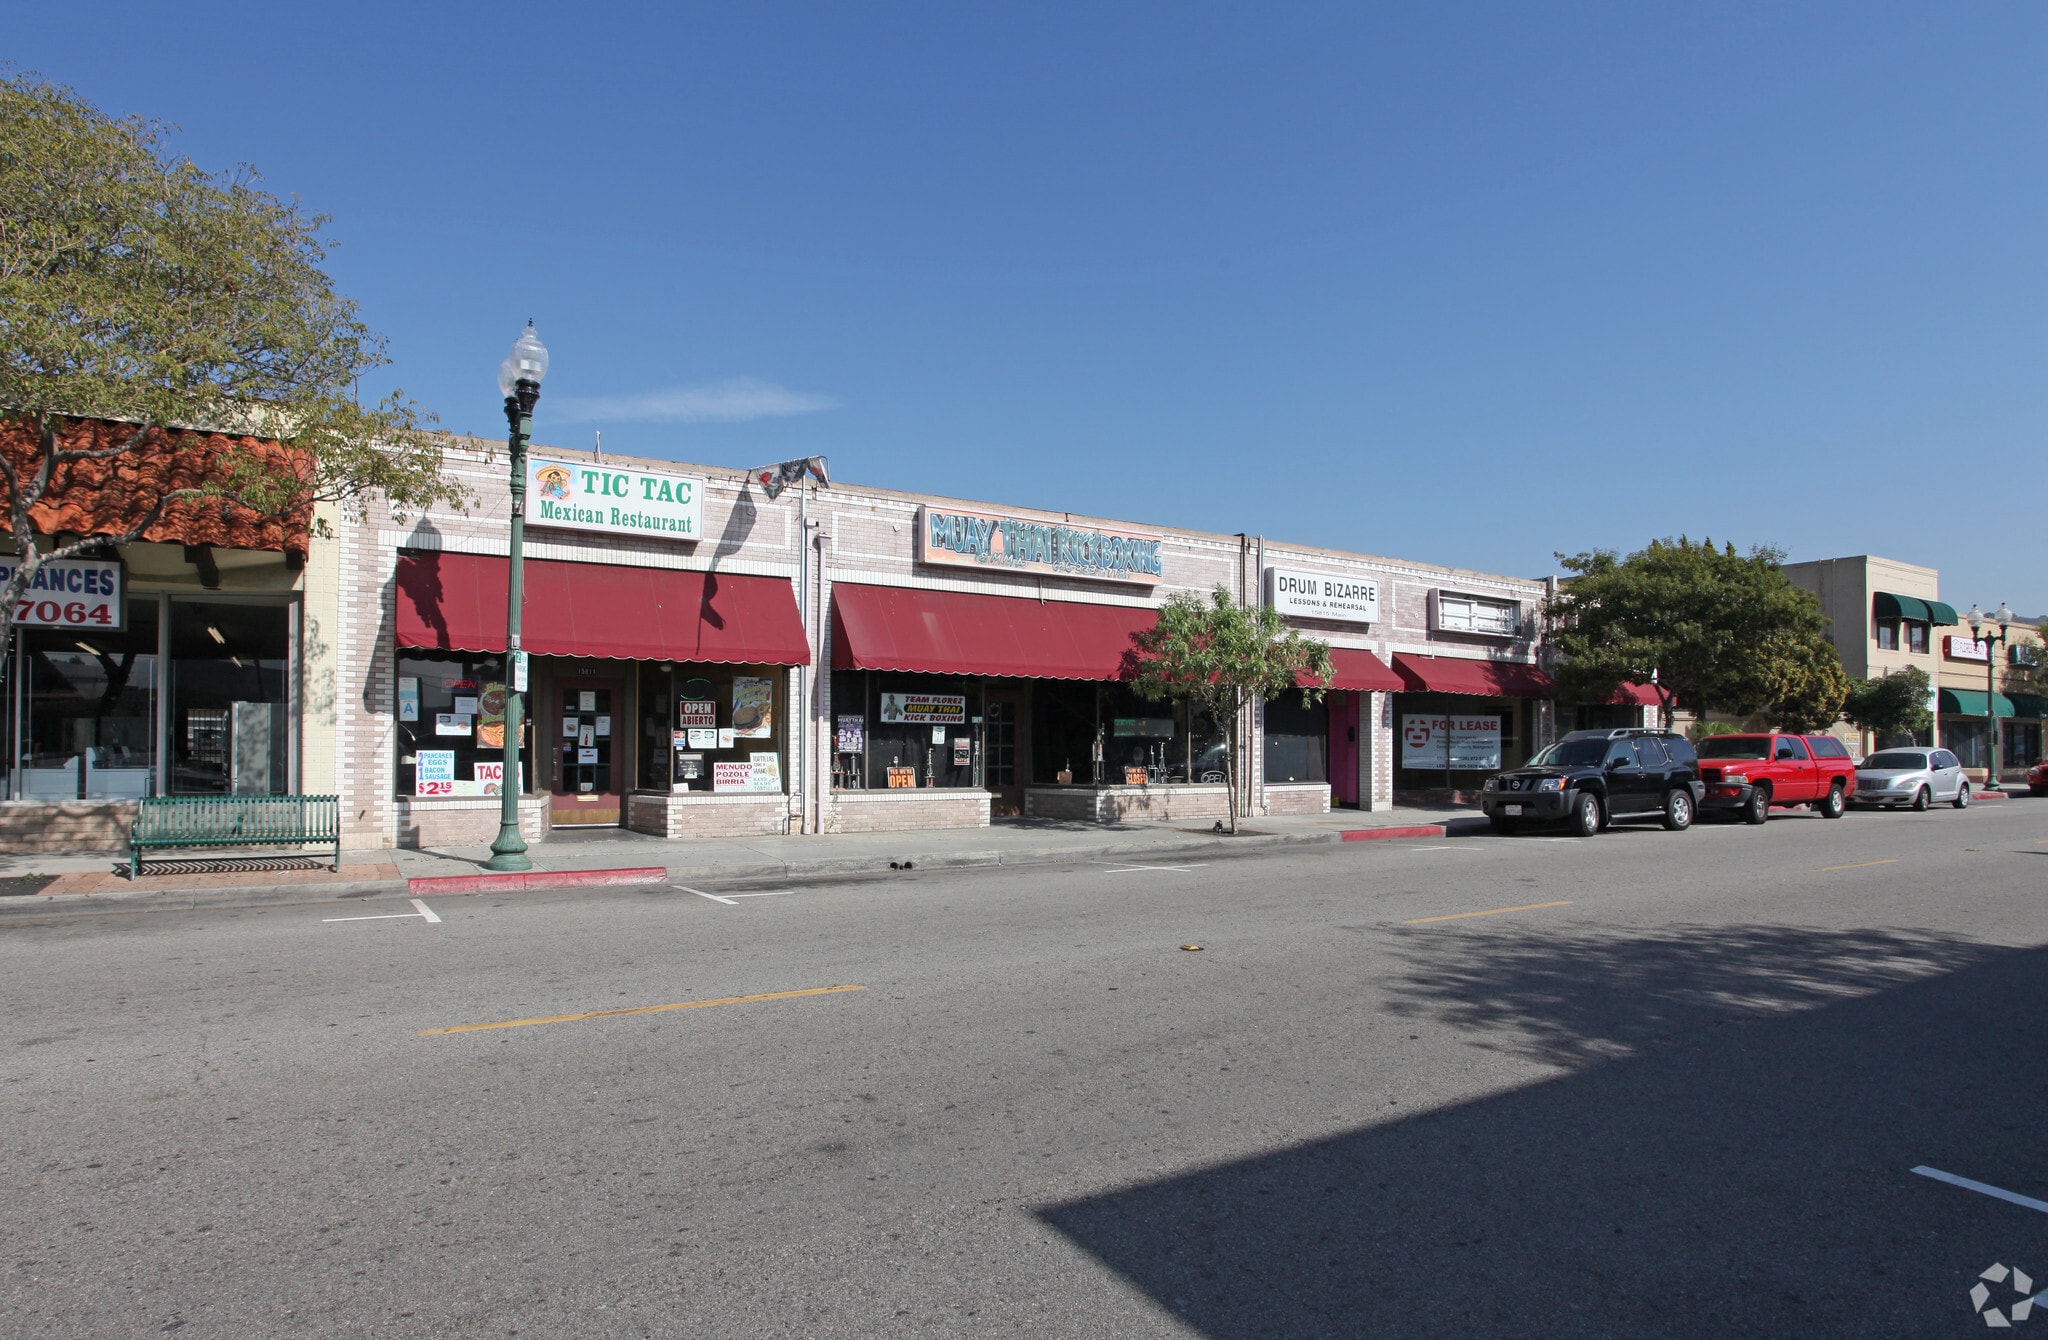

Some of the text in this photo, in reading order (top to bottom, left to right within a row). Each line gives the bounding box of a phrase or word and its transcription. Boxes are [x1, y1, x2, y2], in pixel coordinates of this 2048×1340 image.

[581, 470, 692, 505] TIC TAC
[540, 500, 692, 533] Mexican Restaurant
[931, 513, 995, 554] MUAY
[0, 566, 115, 597] PANCES
[1279, 576, 1375, 602] DRUM BIZARRE
[1289, 597, 1321, 607] LESSONS
[1329, 601, 1367, 611] REHEARSAL
[17, 599, 113, 625] 7064
[444, 678, 477, 689] OPEN
[904, 695, 964, 705] TEAM FLOREZ
[403, 703, 415, 714] A
[684, 703, 712, 714] OPEN
[906, 704, 961, 714] MUAY THAI
[682, 716, 714, 725] ABIERTO
[903, 714, 964, 722] KICK BOXING
[1432, 720, 1498, 731] FOR LEASE
[418, 753, 424, 766] 2
[418, 767, 424, 780] 1
[889, 775, 914, 788] OPEN
